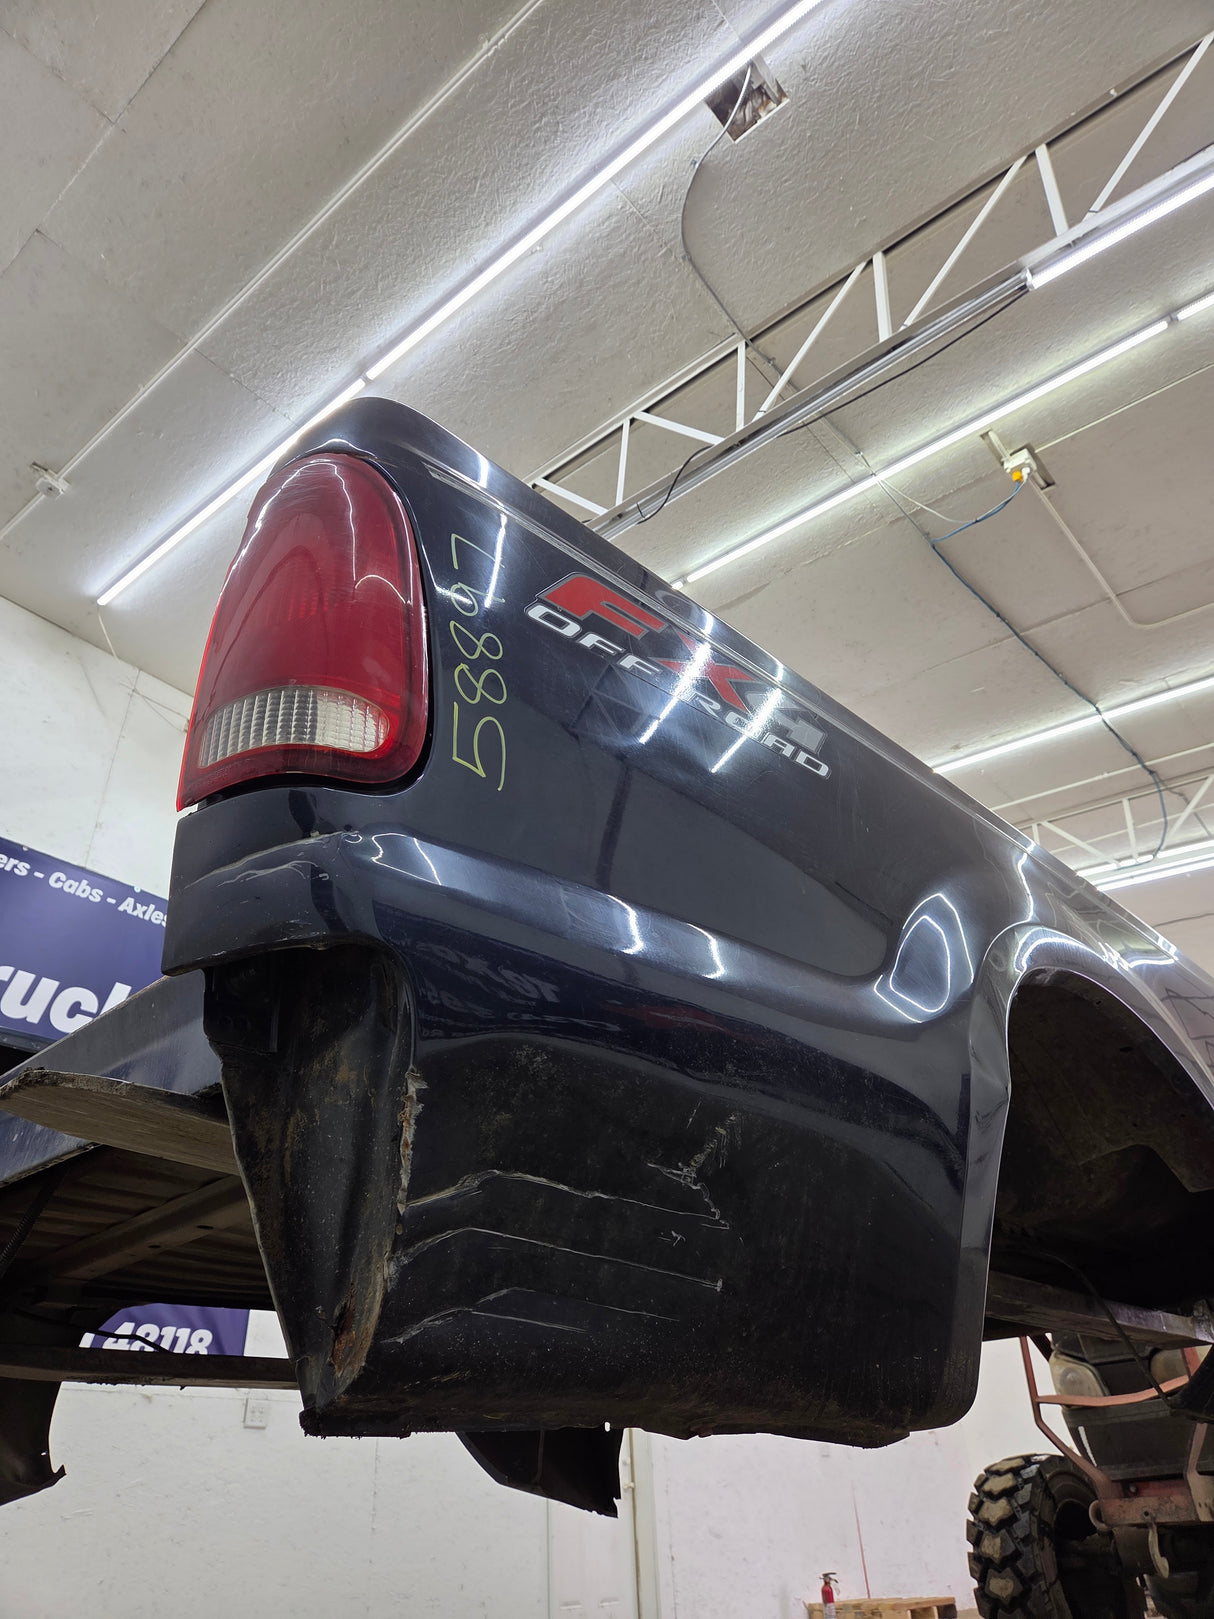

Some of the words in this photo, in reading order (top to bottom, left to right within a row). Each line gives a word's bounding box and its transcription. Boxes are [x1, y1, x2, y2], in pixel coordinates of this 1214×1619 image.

[450, 533, 507, 791] 58897
[525, 604, 663, 675] OFF
[685, 690, 831, 778] ROAD
[542, 573, 827, 753] FX4
[48, 871, 104, 902] Cabs
[102, 1321, 213, 1355] 48118
